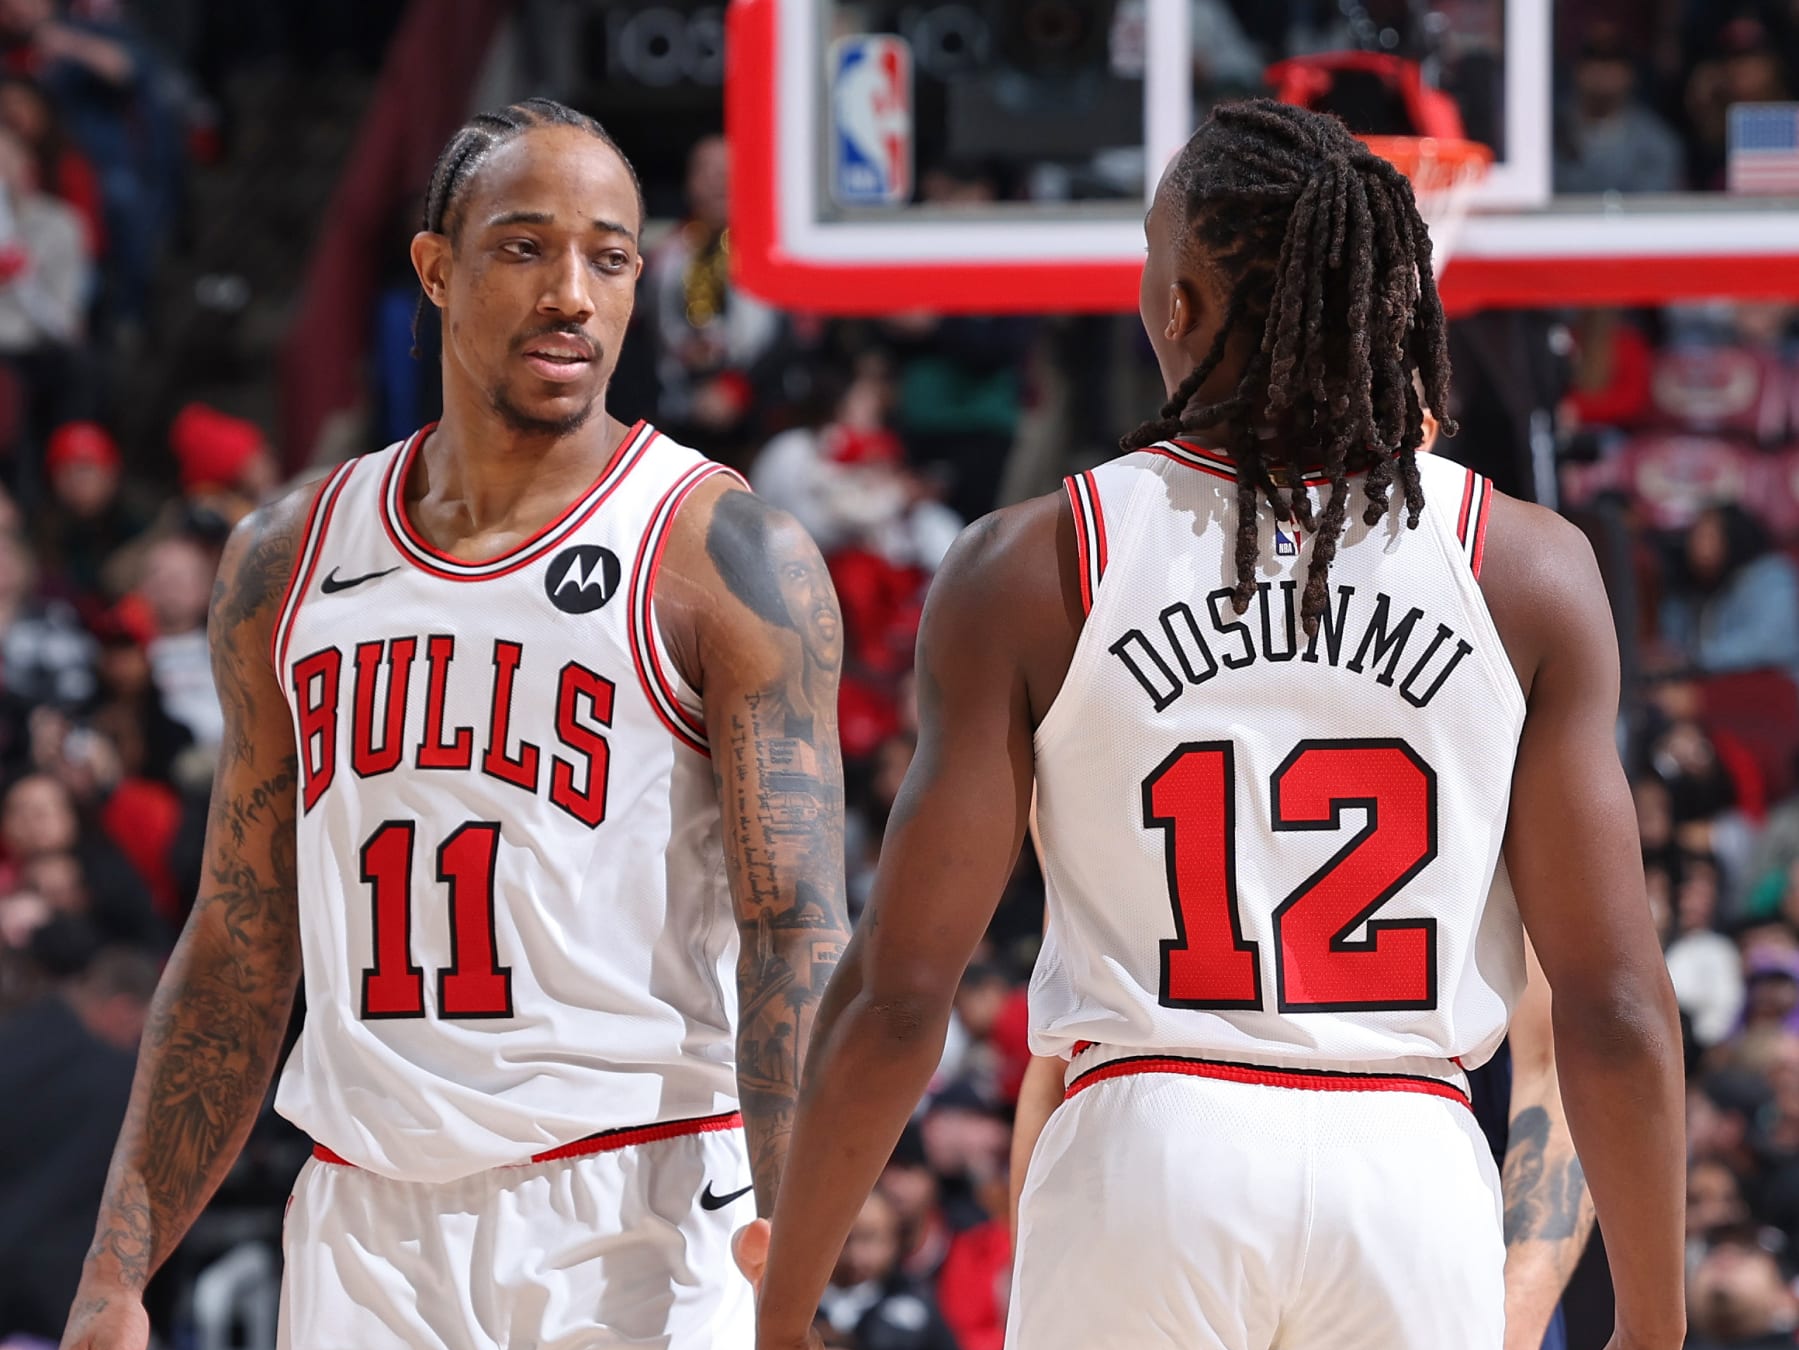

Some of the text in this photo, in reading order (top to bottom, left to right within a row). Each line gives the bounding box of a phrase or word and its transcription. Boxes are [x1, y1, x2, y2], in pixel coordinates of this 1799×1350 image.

[1108, 579, 1474, 713] DOSUNMU
[1279, 543, 1293, 553] NBA
[291, 634, 616, 830] BULLS
[359, 820, 514, 1020] 11
[1142, 737, 1438, 1014] 12
